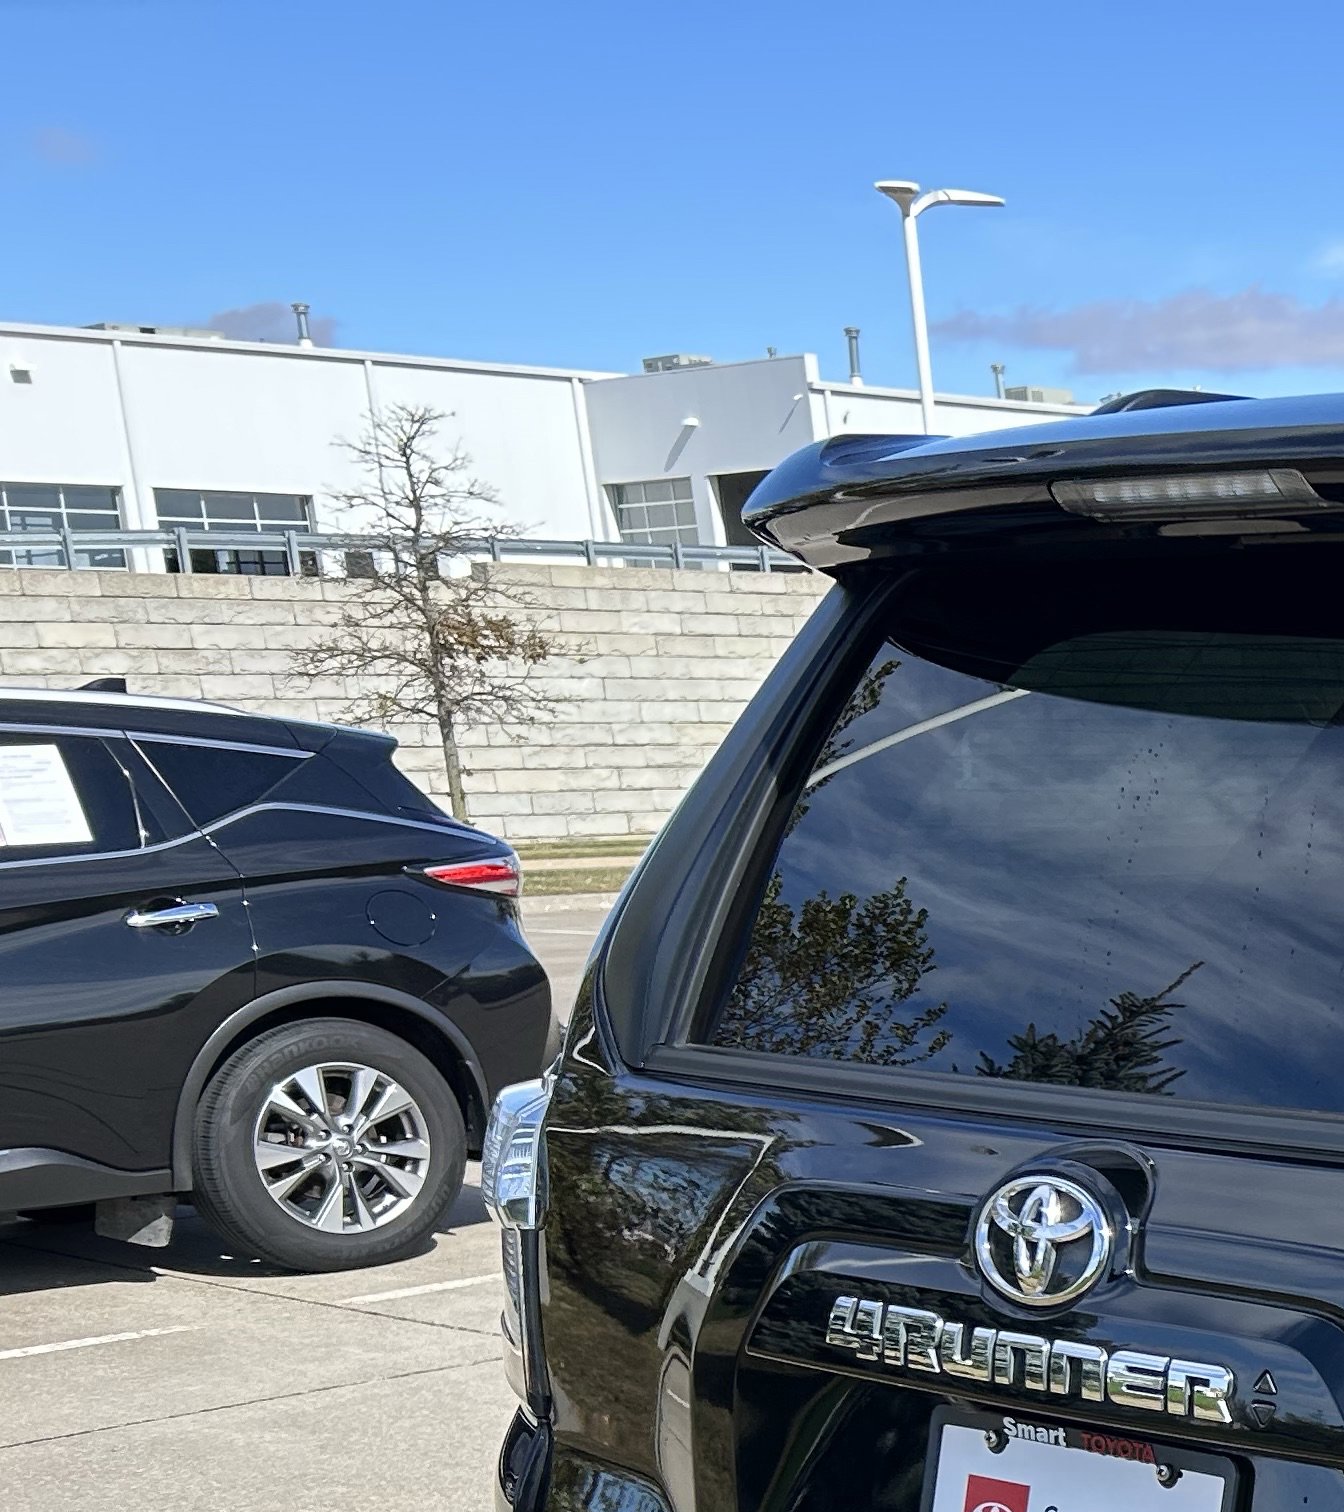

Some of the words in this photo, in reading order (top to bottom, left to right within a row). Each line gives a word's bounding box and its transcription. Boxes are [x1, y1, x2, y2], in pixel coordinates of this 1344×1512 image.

[826, 1296, 1235, 1425] 4RUNNER
[1002, 1416, 1067, 1447] Smart
[1081, 1431, 1157, 1464] TOYOTA
